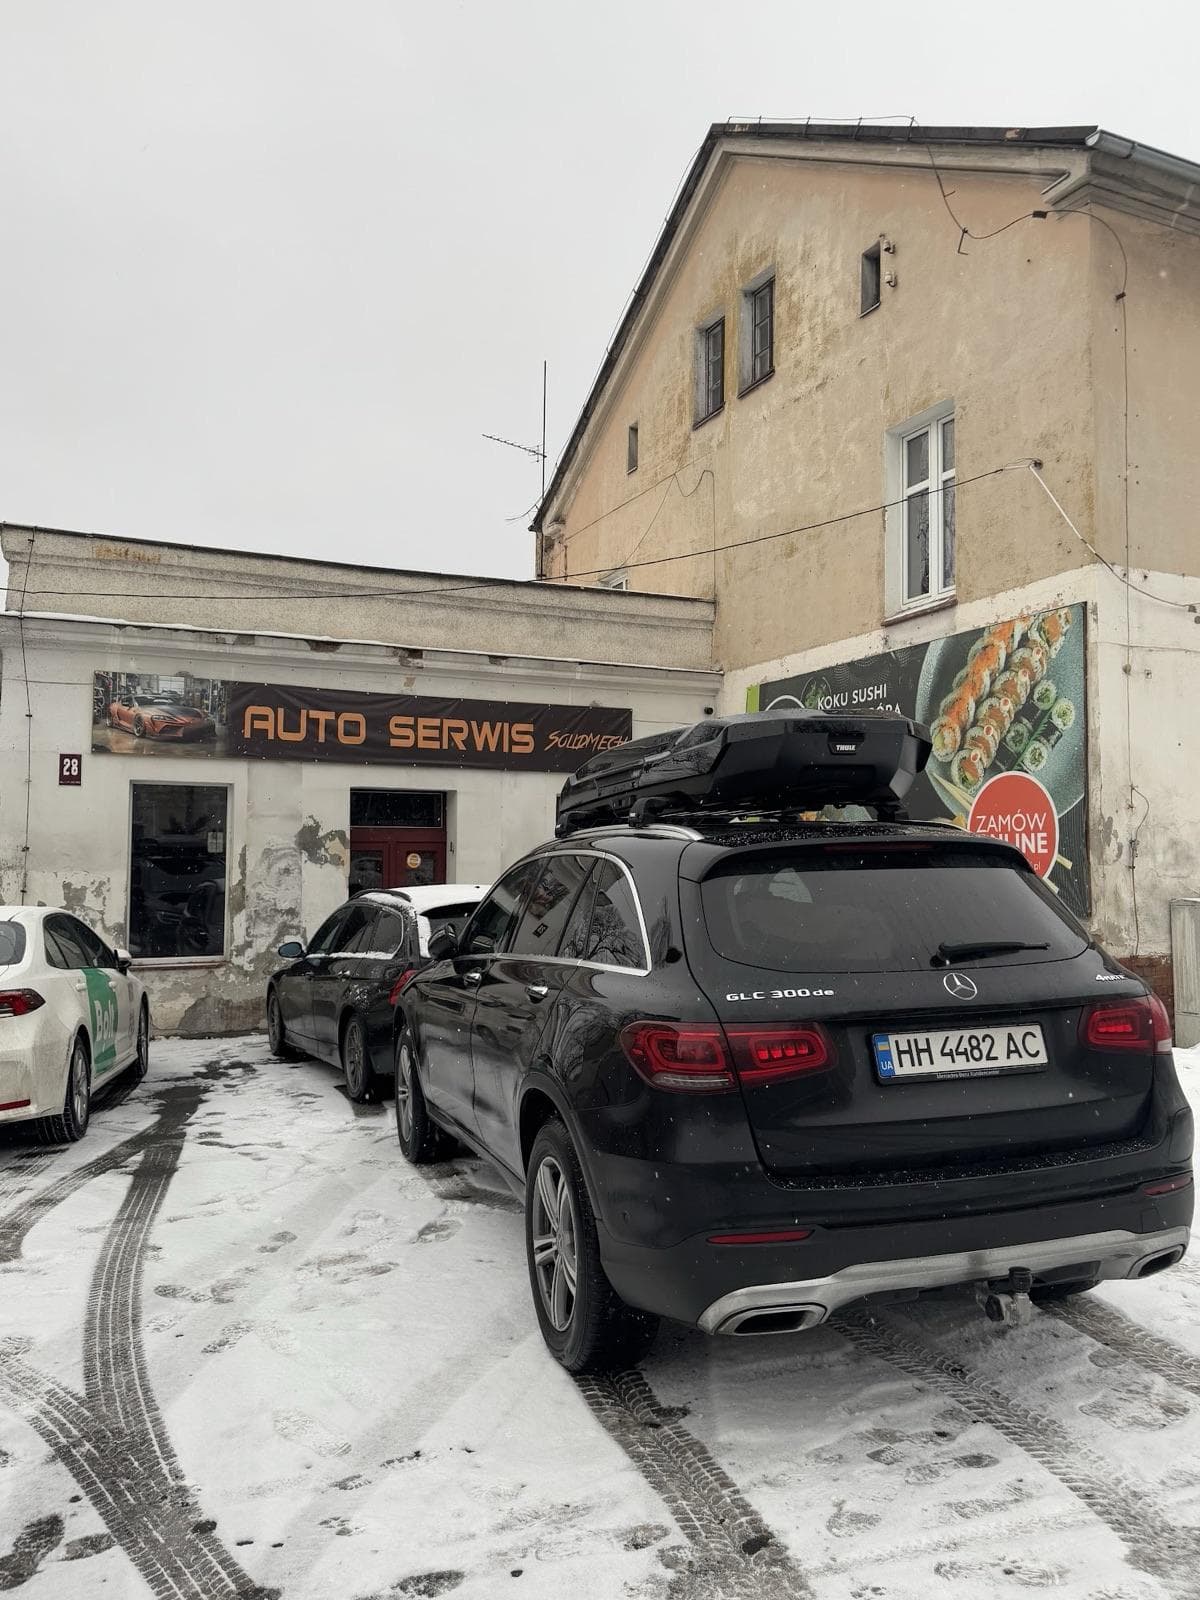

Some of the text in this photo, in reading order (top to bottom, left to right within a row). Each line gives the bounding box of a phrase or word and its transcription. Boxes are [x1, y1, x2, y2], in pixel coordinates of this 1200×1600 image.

[817, 683, 887, 710] KOKU SUSHI
[243, 705, 367, 745] AUTO
[389, 715, 535, 754] SERWIS
[63, 758, 78, 776] 28
[976, 809, 1047, 833] ZAMÓW
[726, 990, 766, 1001] GLC
[894, 1031, 1040, 1068] HH 4482 AC
[881, 1061, 894, 1071] UA
